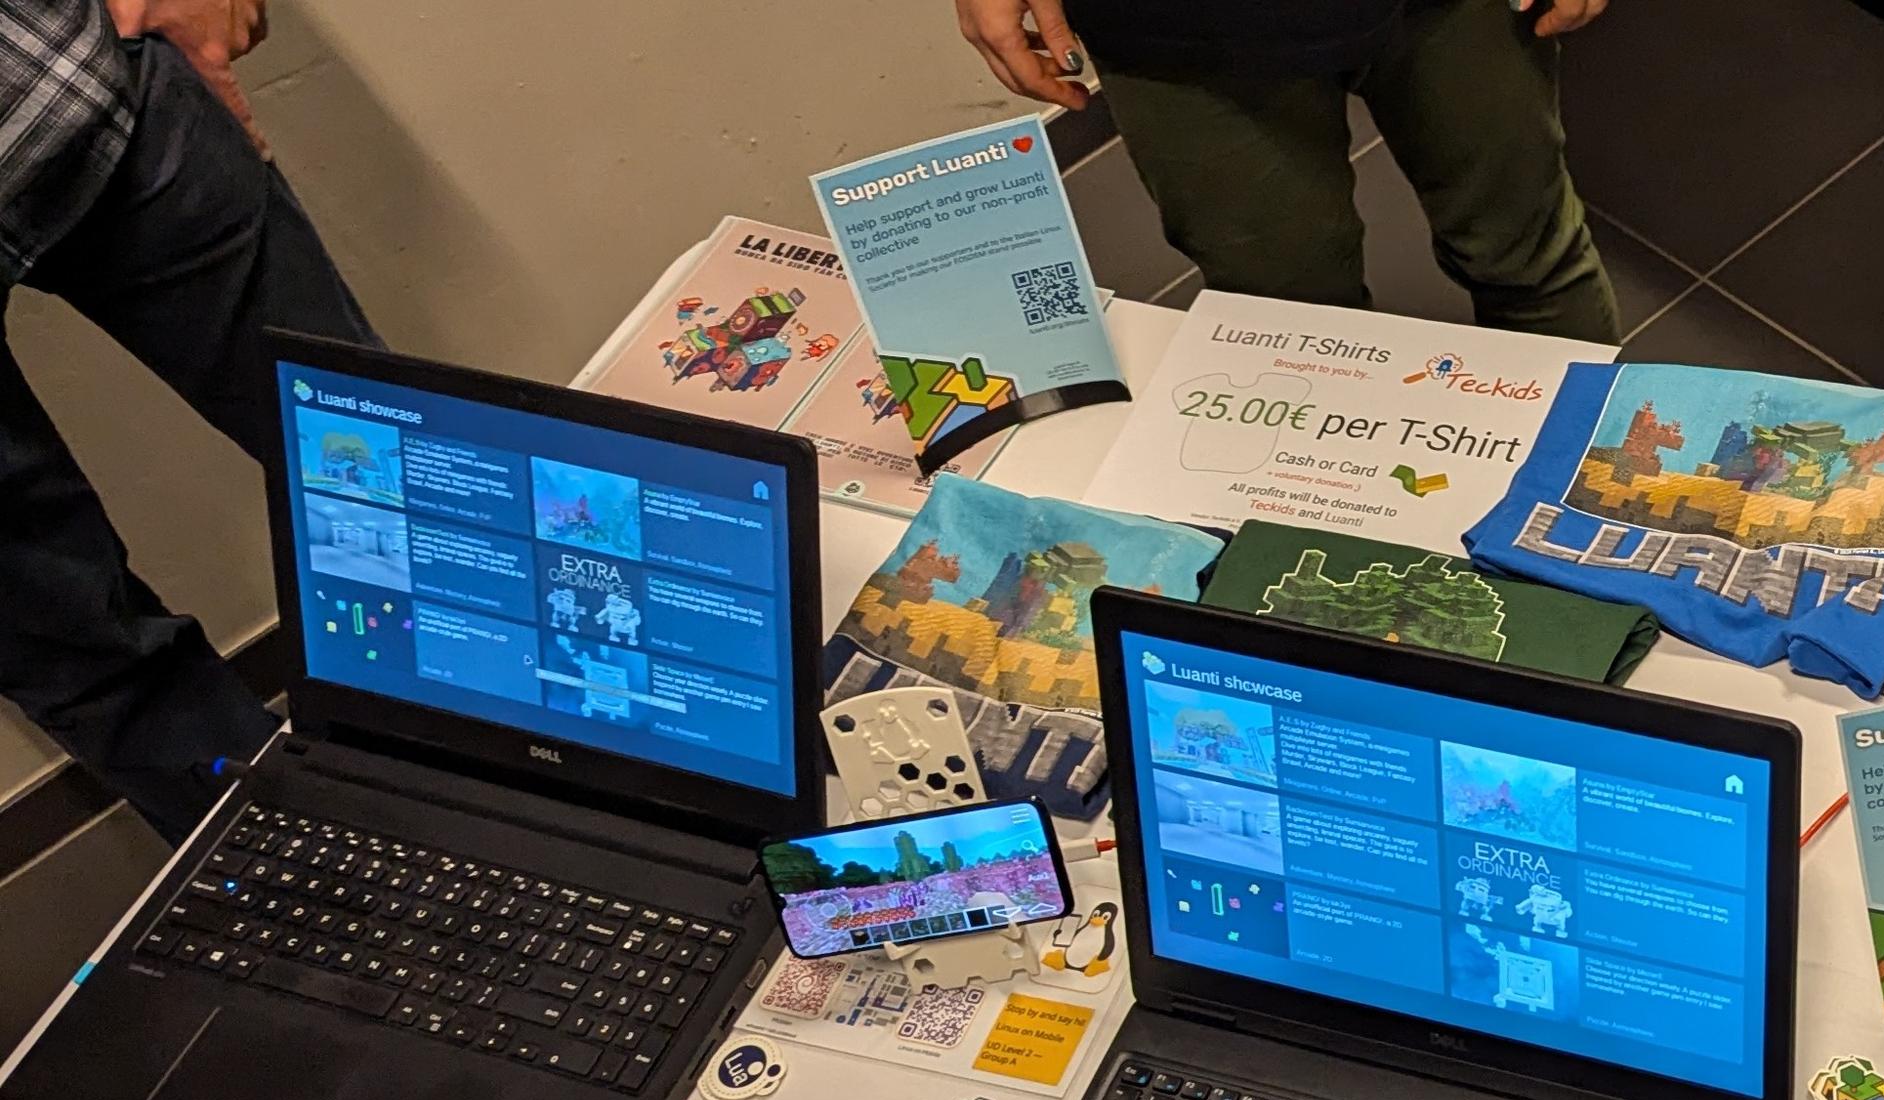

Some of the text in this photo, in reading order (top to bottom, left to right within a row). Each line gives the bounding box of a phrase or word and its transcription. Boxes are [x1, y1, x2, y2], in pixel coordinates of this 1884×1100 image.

[832, 141, 1009, 206] Support Luanti
[845, 171, 1046, 236] Help support and grow Luanti
[851, 185, 1050, 251] by donating to our non-profit
[740, 234, 771, 253] LA
[856, 235, 920, 264] collective
[1210, 323, 1392, 364] Luanti T-Shirts
[1273, 357, 1317, 373] Brought
[1318, 364, 1331, 374] to
[1331, 366, 1352, 377] you
[317, 390, 422, 424] Luanti showcase
[1178, 390, 1522, 463] 25.00€ per T-Shirt
[1275, 451, 1379, 478] Cash or Card
[1273, 471, 1353, 490] voluntary donation
[1228, 482, 1398, 518] All profits will be donated to
[1249, 499, 1364, 528] Teckids and Luanti
[548, 566, 631, 600] ORDINANCE
[560, 553, 622, 584] EXTRA
[1171, 662, 1302, 702] Luanti showcase
[529, 745, 562, 764] DELL
[1864, 782, 1884, 796] by
[1457, 855, 1561, 891] ORDINANCE
[1475, 842, 1550, 874] EXTRA
[1006, 1004, 1025, 1015] Stop
[1027, 1008, 1039, 1018] by
[1039, 1011, 1057, 1021] and
[1058, 1016, 1073, 1026] say
[996, 1022, 1065, 1043] Linux on Mobile
[980, 1051, 1017, 1066] Group A
[987, 1041, 1033, 1058] UD Level 2
[725, 1052, 748, 1086] Lua
